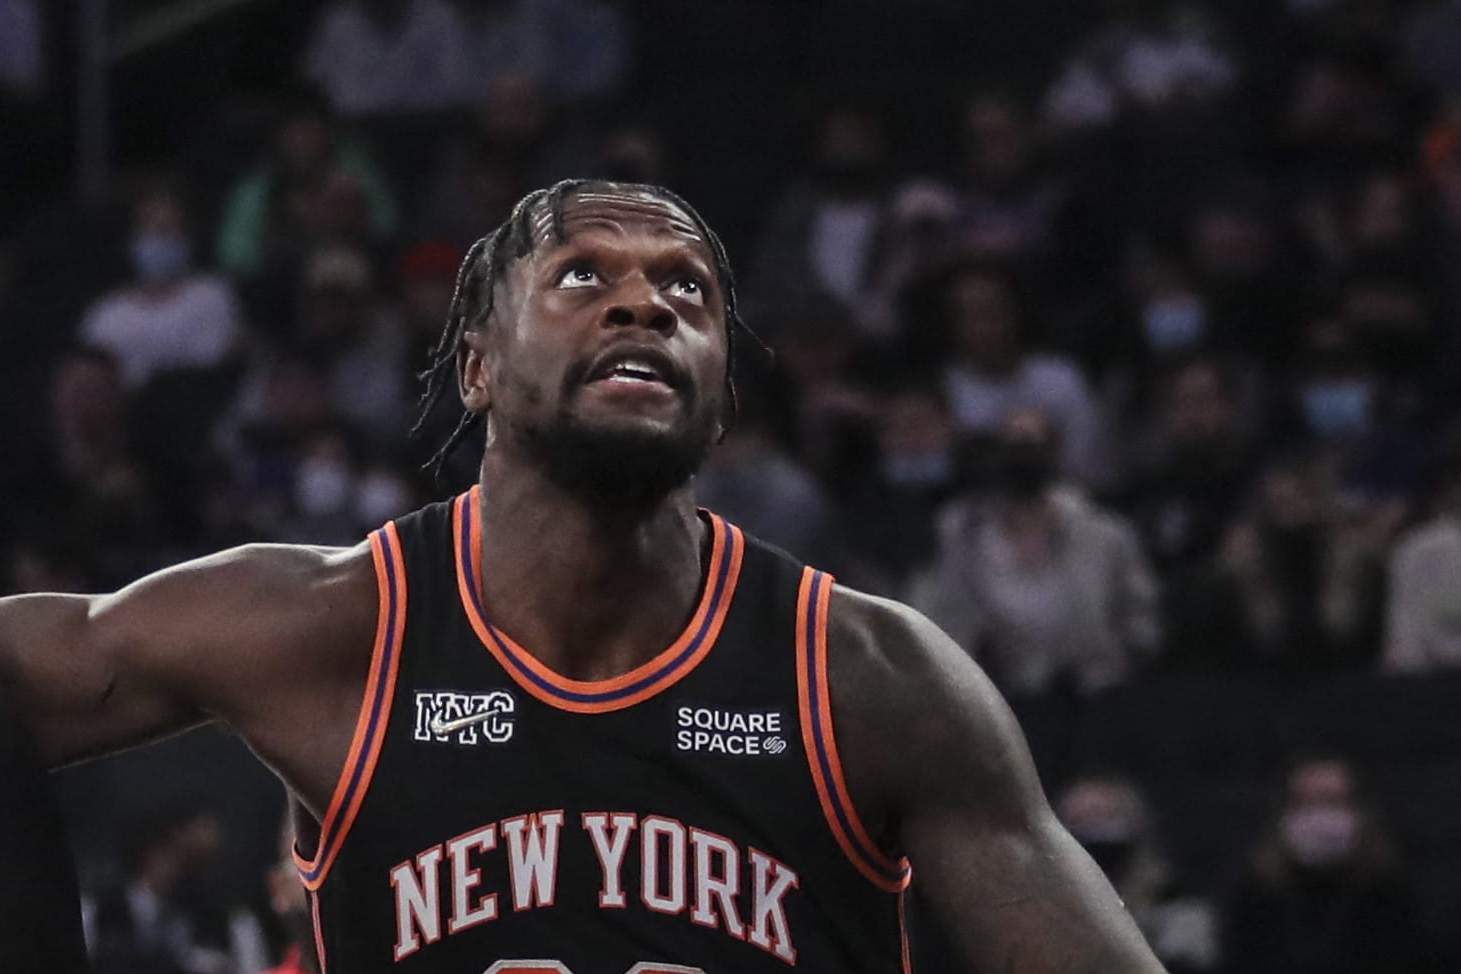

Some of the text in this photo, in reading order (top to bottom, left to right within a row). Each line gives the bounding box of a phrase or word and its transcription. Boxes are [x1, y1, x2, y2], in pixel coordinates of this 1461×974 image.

[415, 692, 514, 745] NYC
[677, 706, 782, 733] SQUARE
[677, 730, 761, 755] SPACE
[390, 809, 800, 966] NEW YORK
